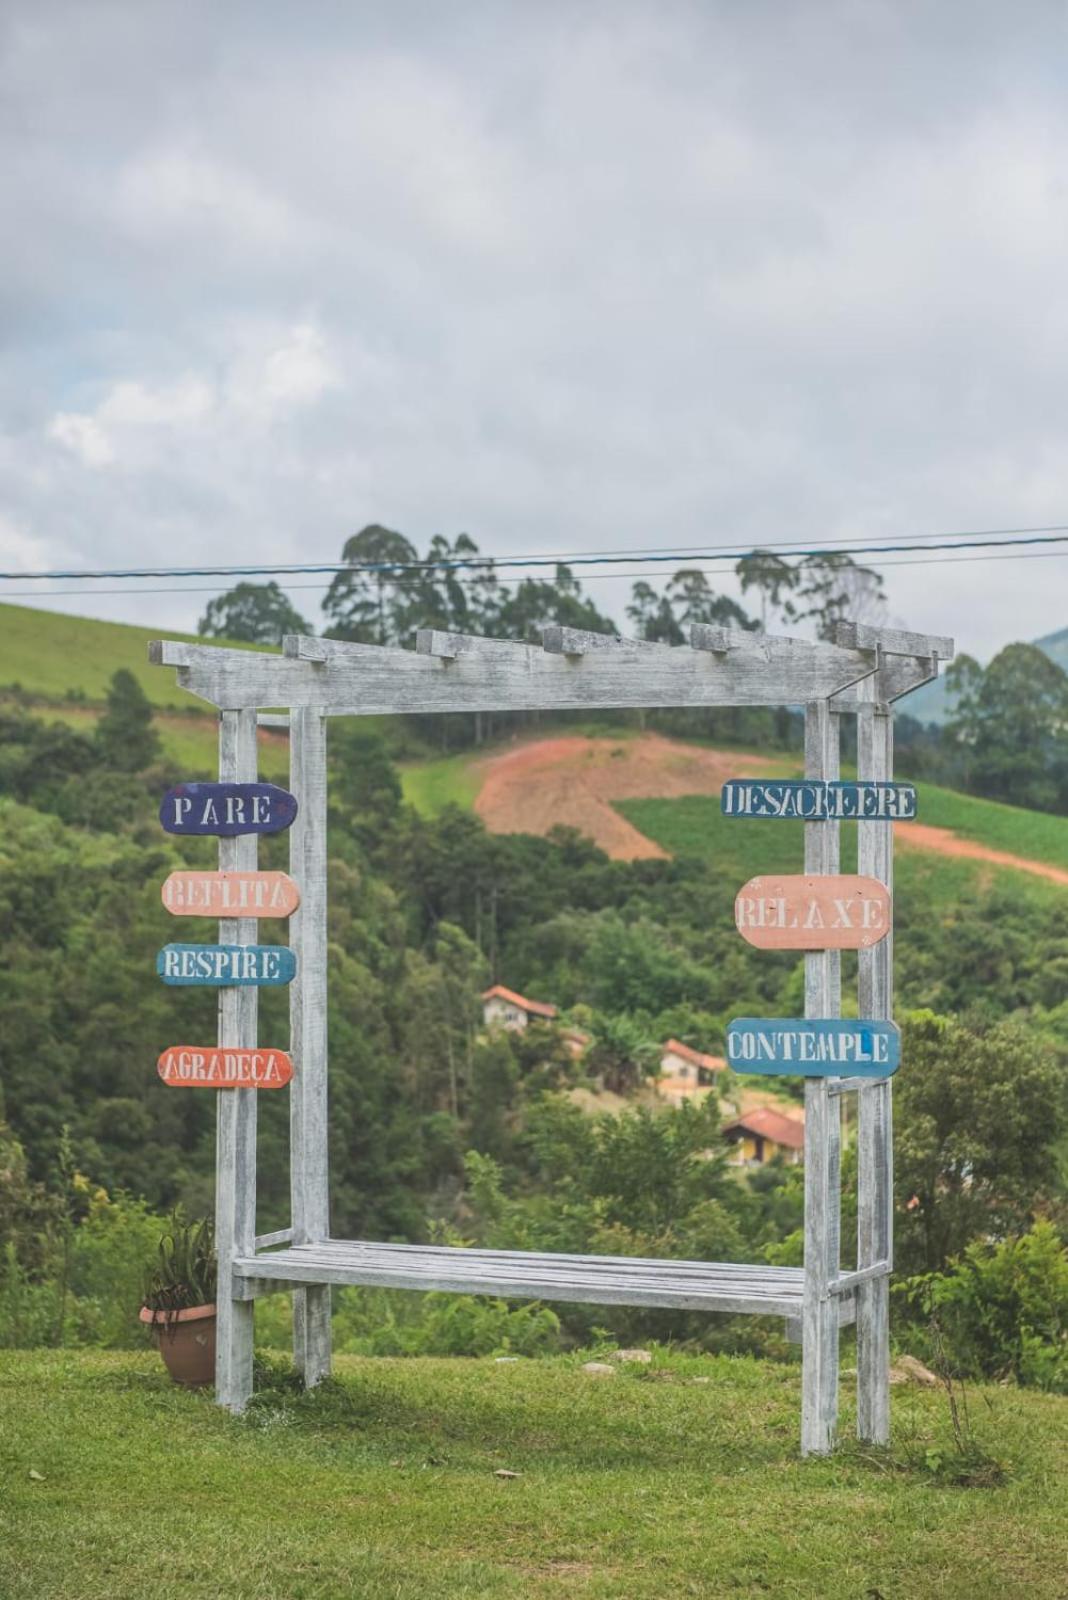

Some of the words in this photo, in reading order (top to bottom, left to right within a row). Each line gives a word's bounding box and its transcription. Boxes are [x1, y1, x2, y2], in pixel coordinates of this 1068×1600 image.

[173, 796, 271, 825] PARE
[165, 880, 289, 908] REFLITA
[737, 897, 883, 929] RELAXE
[164, 950, 281, 979] RESPIRE
[728, 1031, 889, 1063] CONTEMPLE
[163, 1052, 282, 1087] AGRADEÇA
